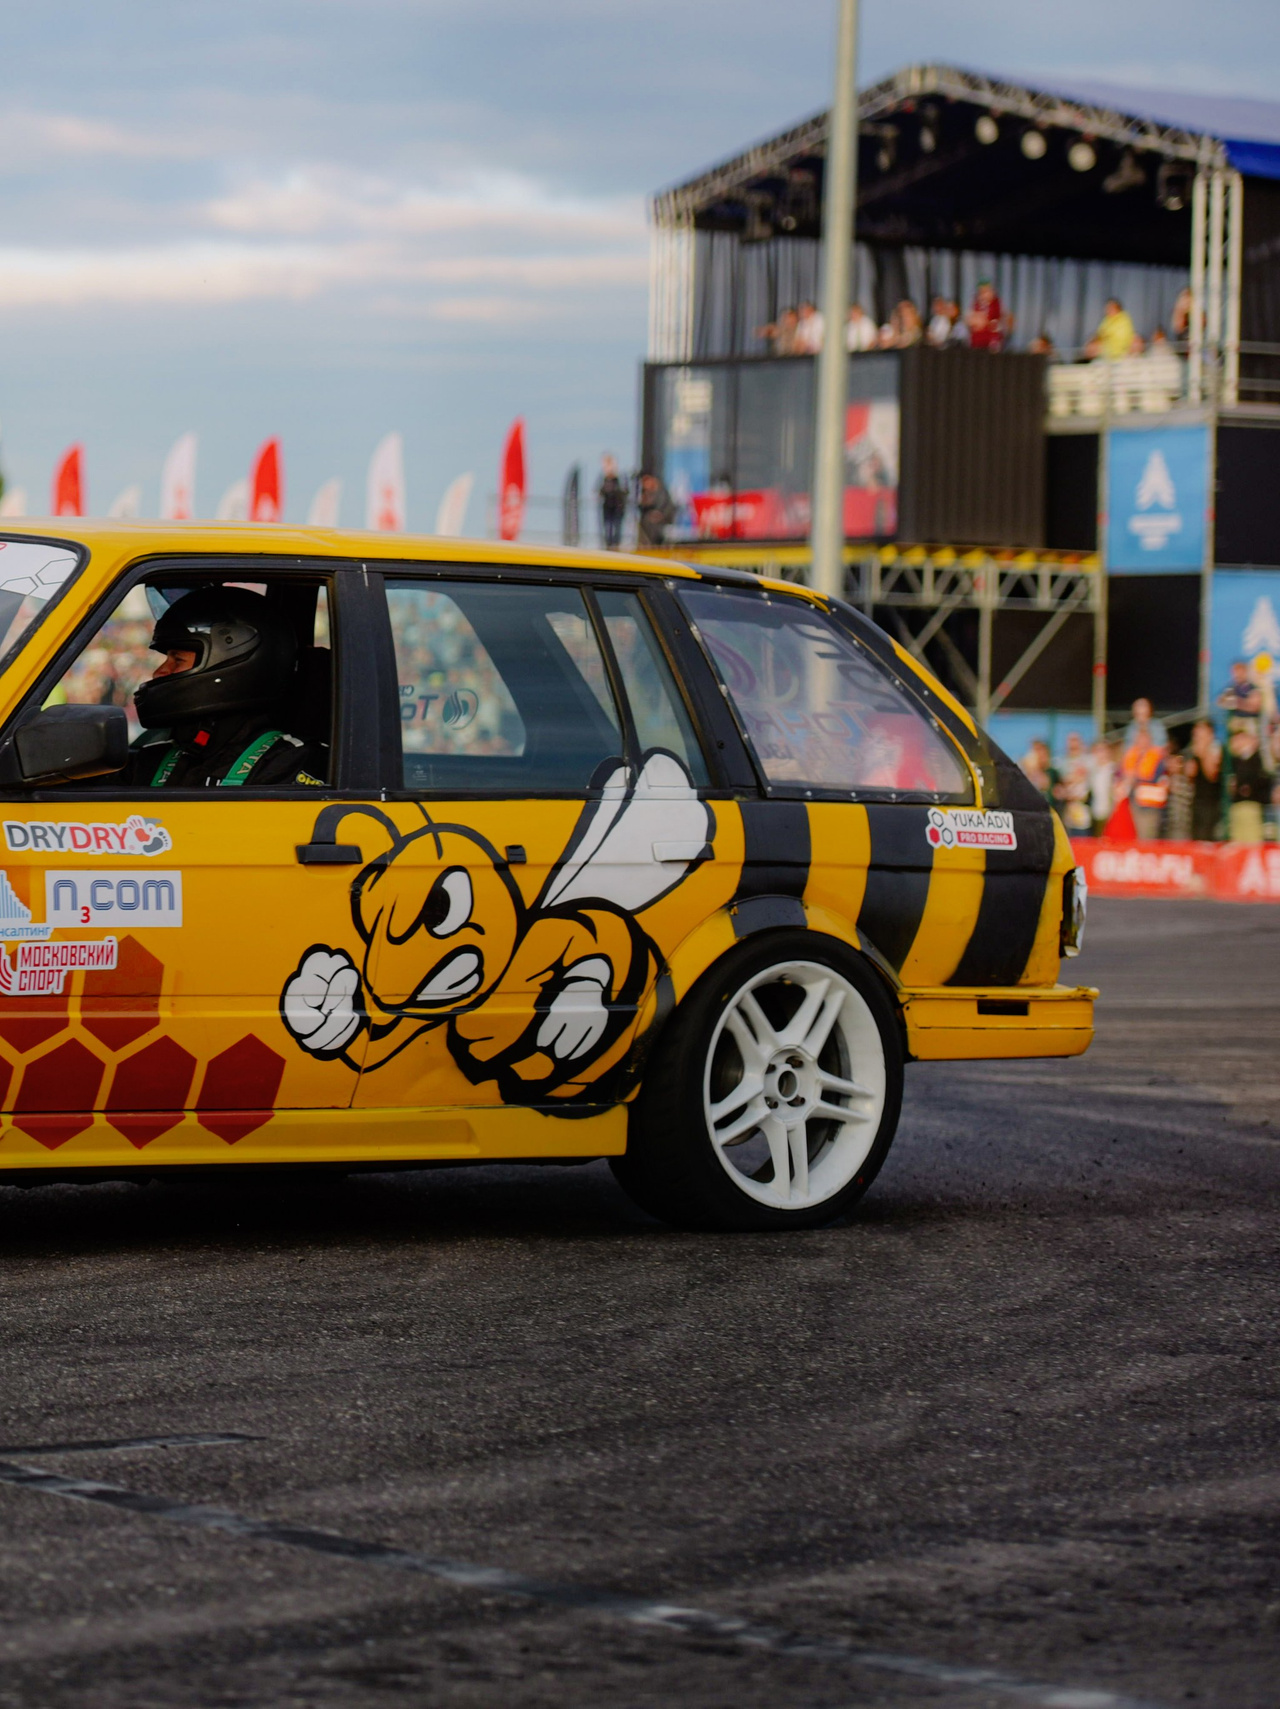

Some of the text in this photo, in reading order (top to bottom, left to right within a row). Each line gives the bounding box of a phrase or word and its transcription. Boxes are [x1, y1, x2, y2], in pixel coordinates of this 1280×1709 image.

[951, 813, 1010, 829] YUKA ADV
[6, 824, 128, 849] DRYDRY
[960, 832, 1010, 844] PRO RACING
[21, 940, 115, 967] МОСКОВСКИЙ
[19, 969, 63, 991] СПОРТ
